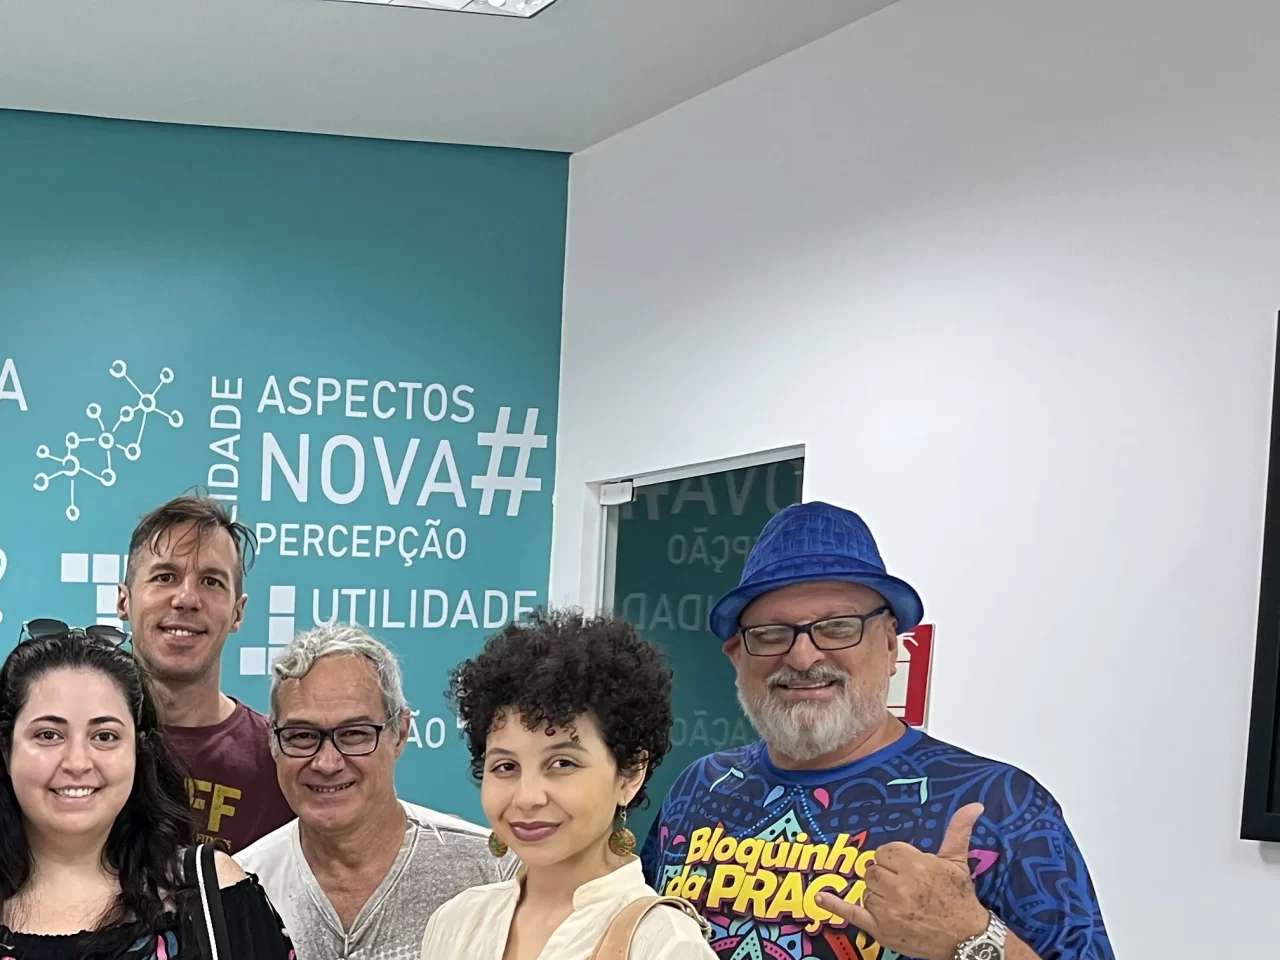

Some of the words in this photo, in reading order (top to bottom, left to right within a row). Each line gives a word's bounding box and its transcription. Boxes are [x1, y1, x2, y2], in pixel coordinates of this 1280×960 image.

[257, 375, 475, 423] ASPECTOS
[208, 376, 242, 523] IDADE
[261, 432, 467, 509] NOVA
[256, 519, 467, 567] PERCEPÇÃO
[312, 588, 538, 629] UTILIDADE
[665, 865, 707, 900] da
